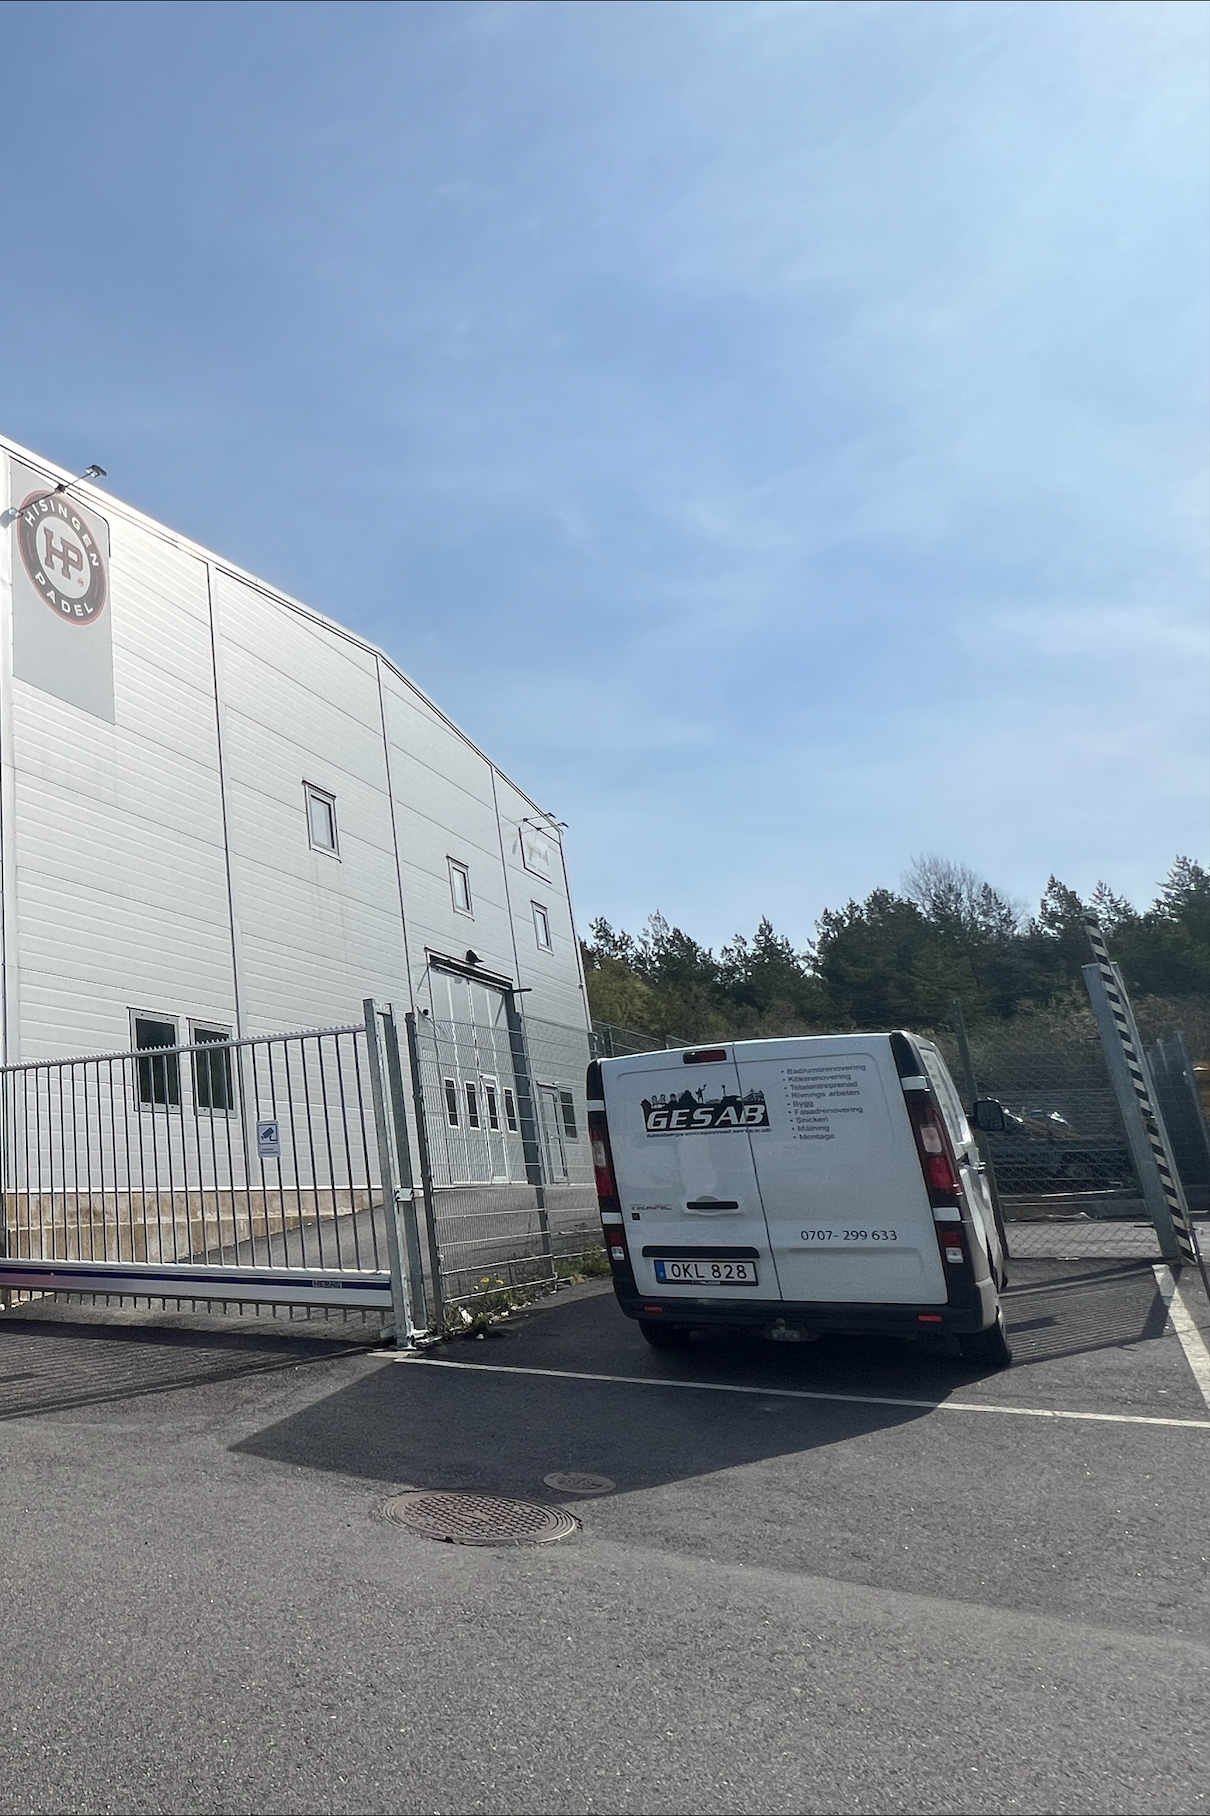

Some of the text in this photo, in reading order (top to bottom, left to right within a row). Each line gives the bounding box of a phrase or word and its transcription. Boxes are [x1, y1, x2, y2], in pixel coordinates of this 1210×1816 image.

[24, 499, 99, 567] HISINGEN
[43, 526, 83, 580] HP
[34, 571, 94, 617] PADEL
[786, 1065, 867, 1075] Badrumsrenovering
[787, 1074, 852, 1082] Köksrenovering
[790, 1081, 858, 1091] Totalentreprenad
[791, 1091, 826, 1099] Rivnings
[792, 1100, 814, 1108] Bygg
[794, 1107, 864, 1115] Fasadrenovering
[647, 1104, 766, 1130] GESAB
[796, 1116, 829, 1124] Snickeri
[799, 1133, 836, 1141] Montage
[800, 1230, 898, 1241] 0707- 299 633
[671, 1263, 747, 1279] OKL 828
